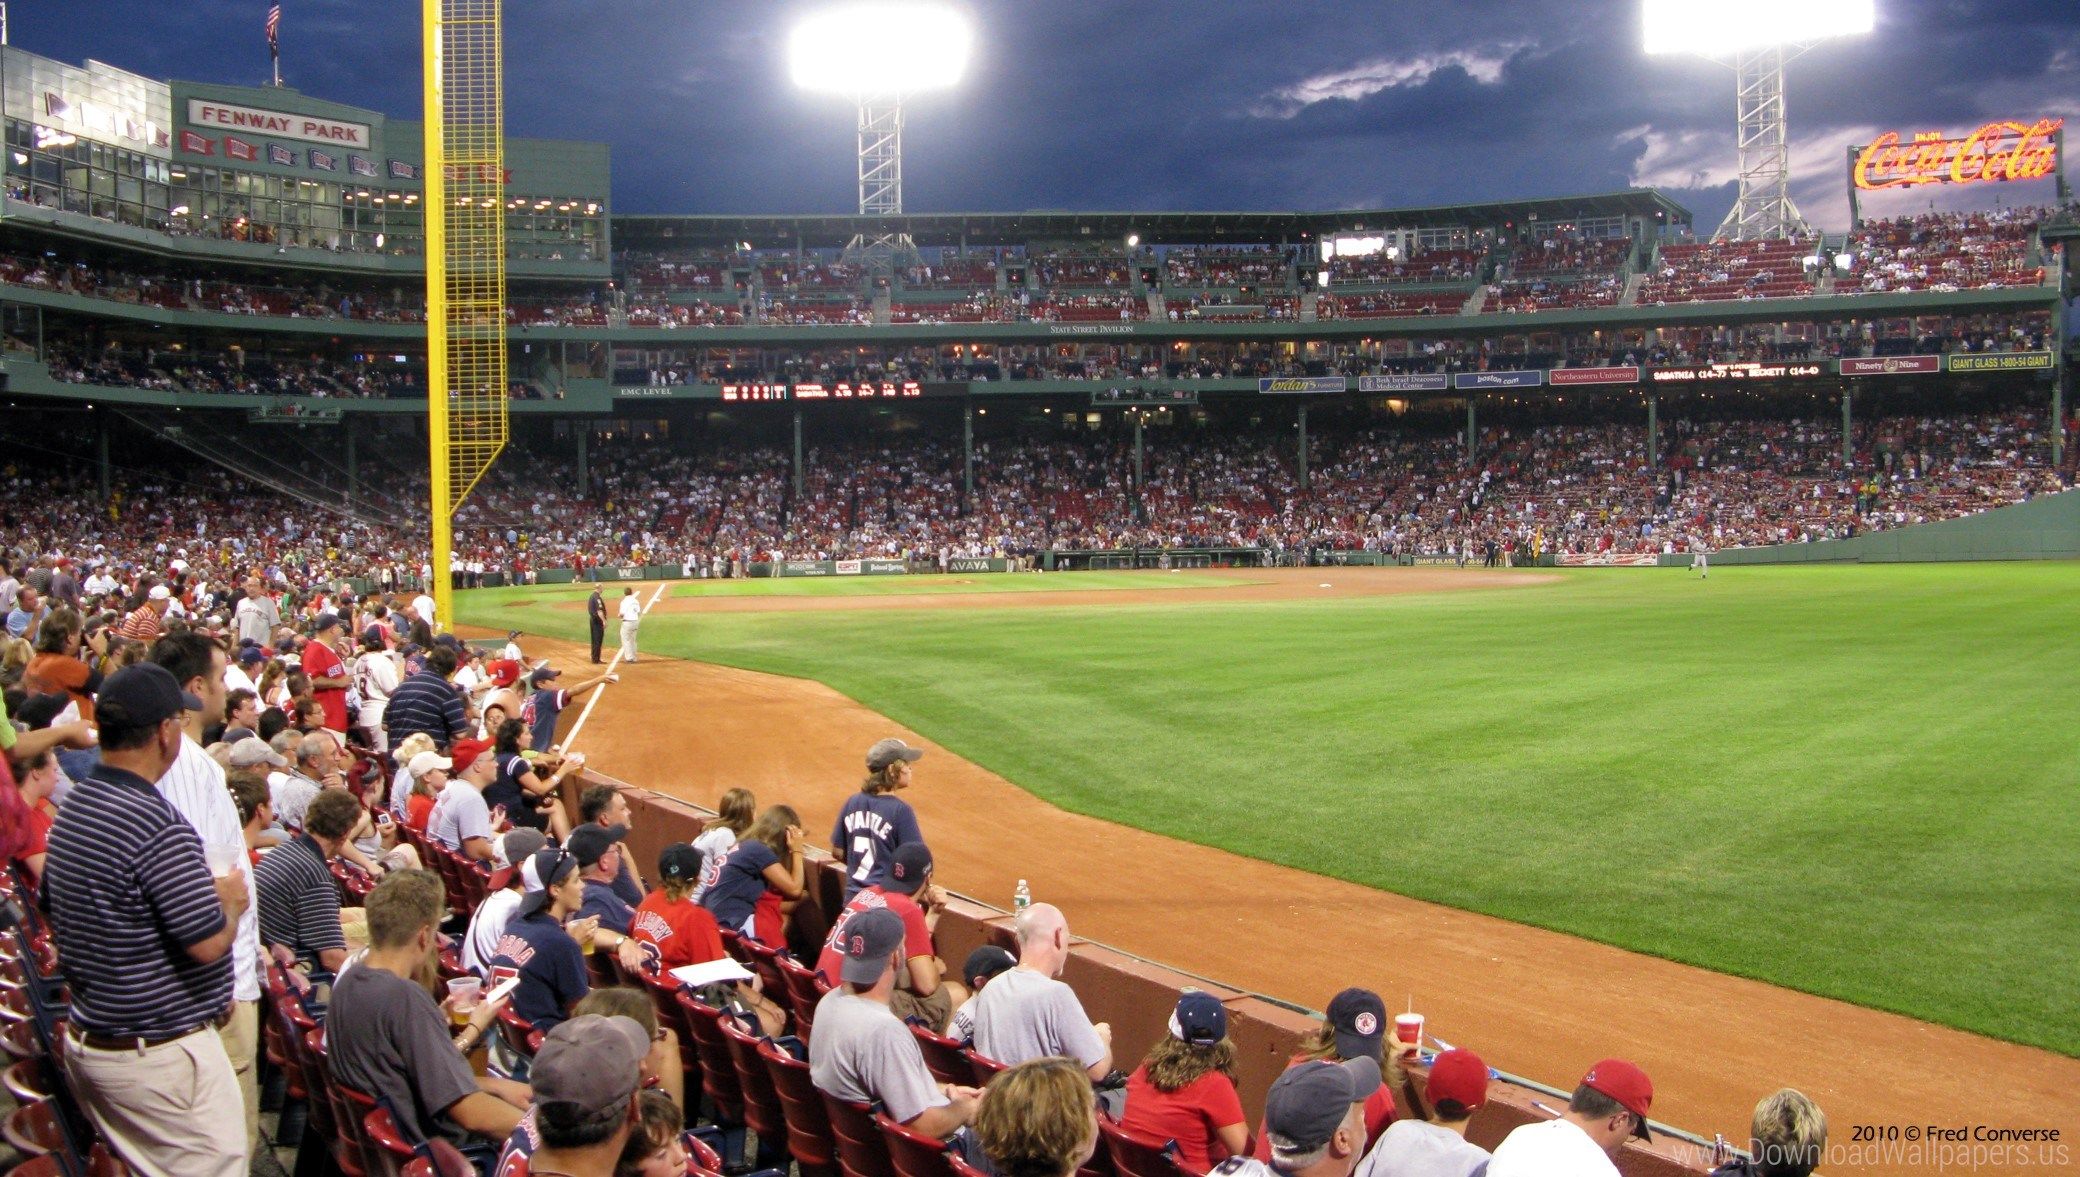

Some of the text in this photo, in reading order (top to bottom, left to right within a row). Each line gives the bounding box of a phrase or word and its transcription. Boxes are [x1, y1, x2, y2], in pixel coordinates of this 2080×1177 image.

[202, 106, 359, 142] FENWAY PARK
[1914, 132, 1942, 142] ENJOY
[1050, 325, 1134, 334] STATE STREET PAVILION
[1855, 362, 1883, 370] Ninety
[1899, 360, 1919, 369] Nine
[1952, 358, 1974, 369] GIANT
[1975, 357, 1998, 368] GLASS
[2027, 355, 2049, 367] GIANT
[1554, 371, 1635, 381] Northeastern University
[1653, 371, 1695, 380] SABATHIA
[1748, 367, 1786, 377] BECKETT
[1267, 378, 1316, 391] Jordan's
[621, 388, 641, 396] EMC
[951, 561, 989, 571] AVAYA
[851, 836, 876, 881] 7
[851, 935, 865, 956] B
